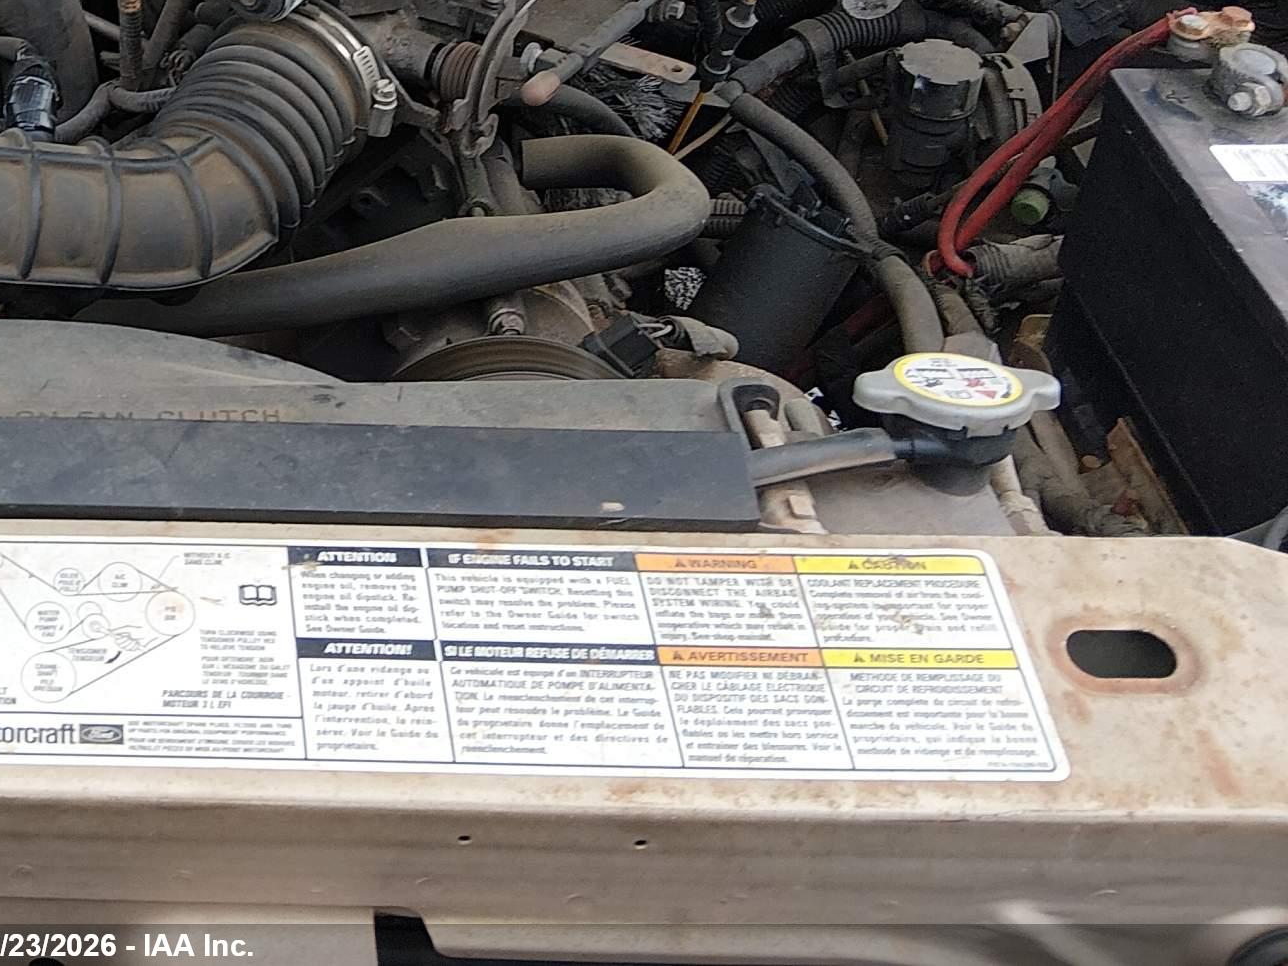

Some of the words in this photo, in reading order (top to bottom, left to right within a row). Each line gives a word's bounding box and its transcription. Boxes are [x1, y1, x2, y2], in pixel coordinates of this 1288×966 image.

[317, 551, 397, 562] ATTENTION
[448, 554, 461, 564] IF
[463, 554, 510, 565] ENGINE
[512, 555, 549, 565] FAILS
[553, 556, 567, 566] TO
[569, 557, 614, 566] START
[689, 559, 757, 569] WARNING
[324, 643, 412, 655] ATTENTION!
[458, 646, 473, 657] LE
[474, 647, 523, 657] MOTEUR
[525, 648, 570, 659] REFUSE
[572, 649, 588, 659] DE
[688, 651, 808, 662] AVERTISSEMENT
[870, 653, 904, 663] MISE
[910, 654, 929, 663] EN
[934, 654, 985, 664] GARDE
